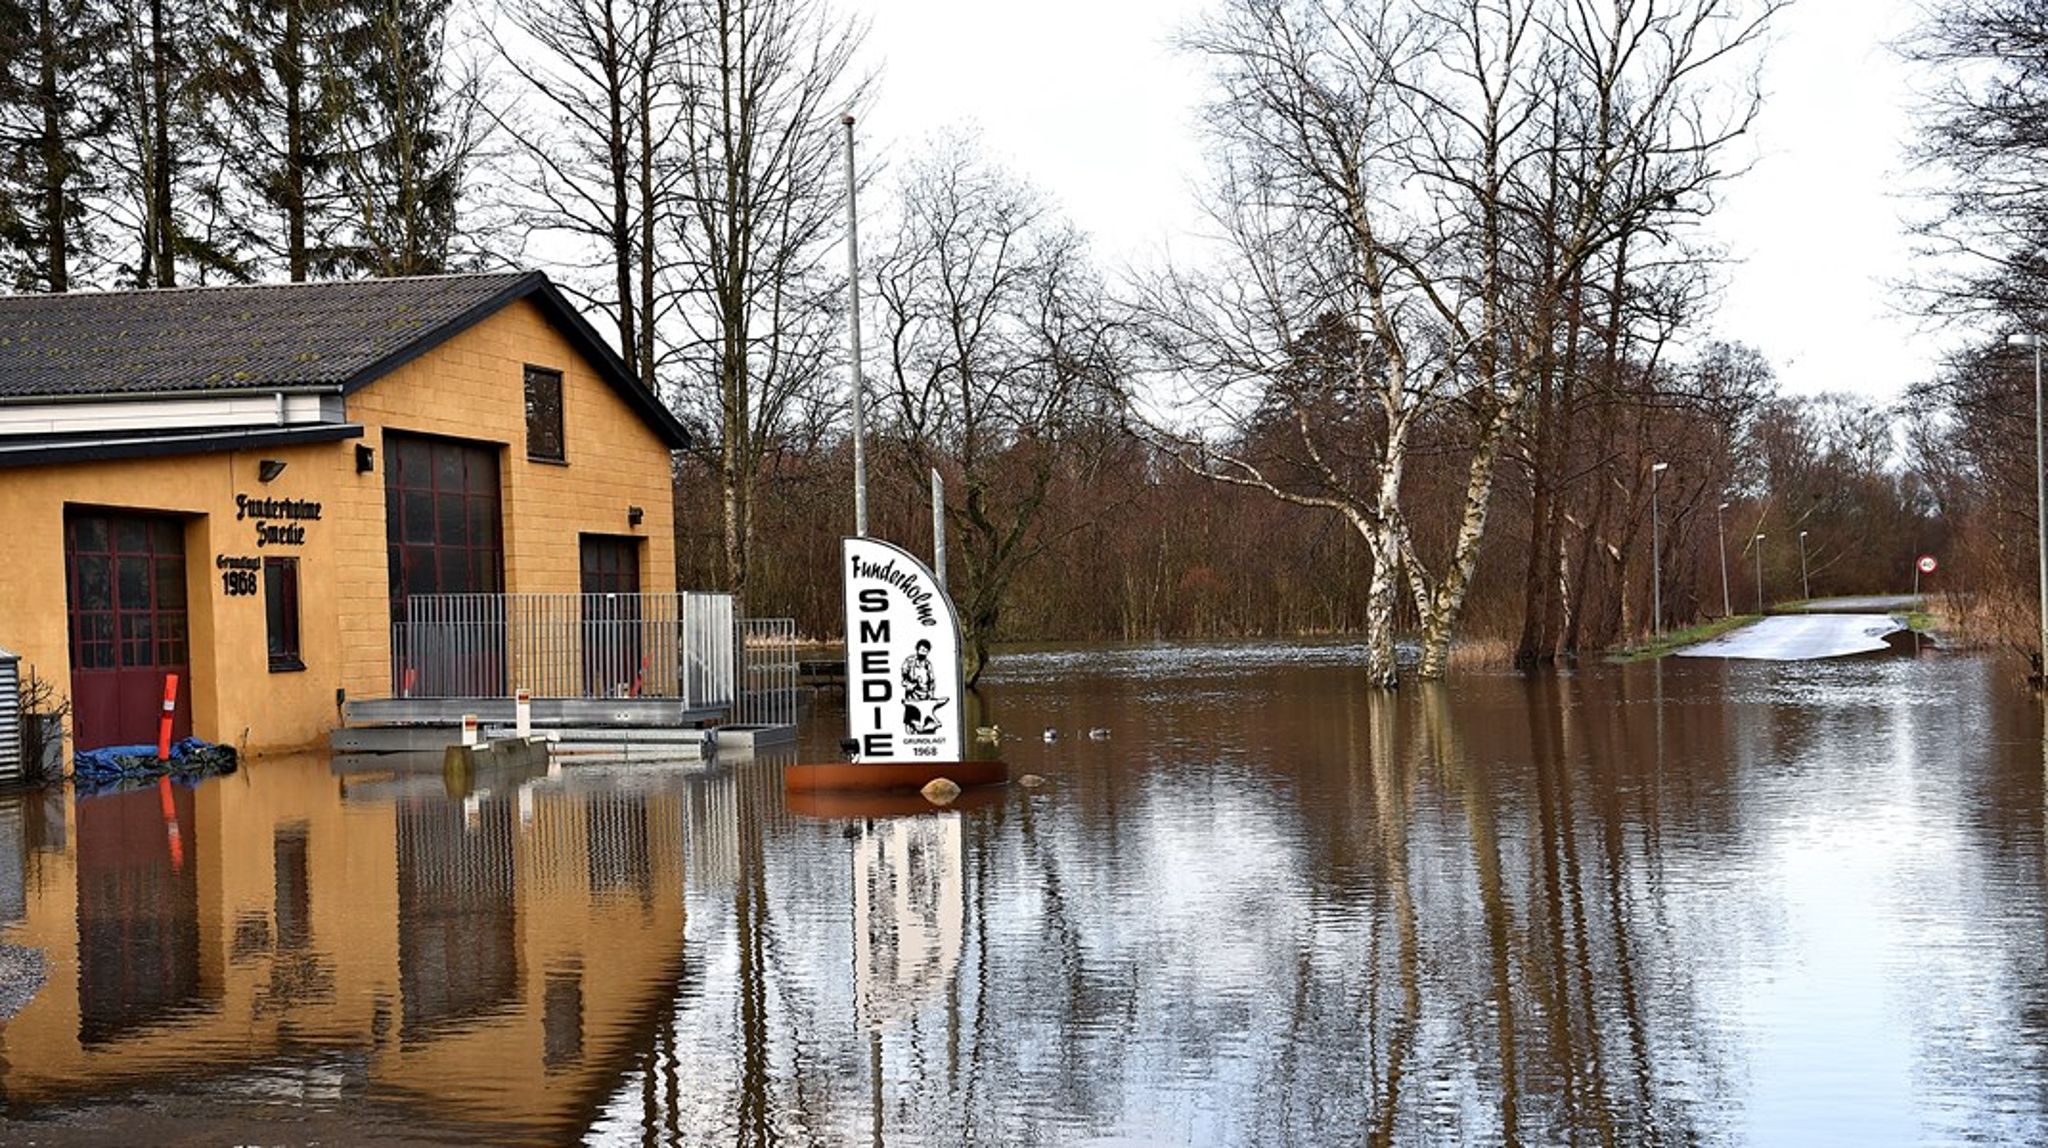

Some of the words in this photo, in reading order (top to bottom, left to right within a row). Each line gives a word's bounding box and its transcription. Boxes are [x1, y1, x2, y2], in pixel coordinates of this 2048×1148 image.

[236, 494, 322, 521] Funderholme
[256, 521, 305, 547] Smedie
[222, 570, 257, 596] 1968
[851, 555, 937, 627] Funderholme
[858, 589, 894, 757] SMEDIE
[903, 737, 946, 745] GRUNDLAGT
[913, 747, 938, 757] 1968
